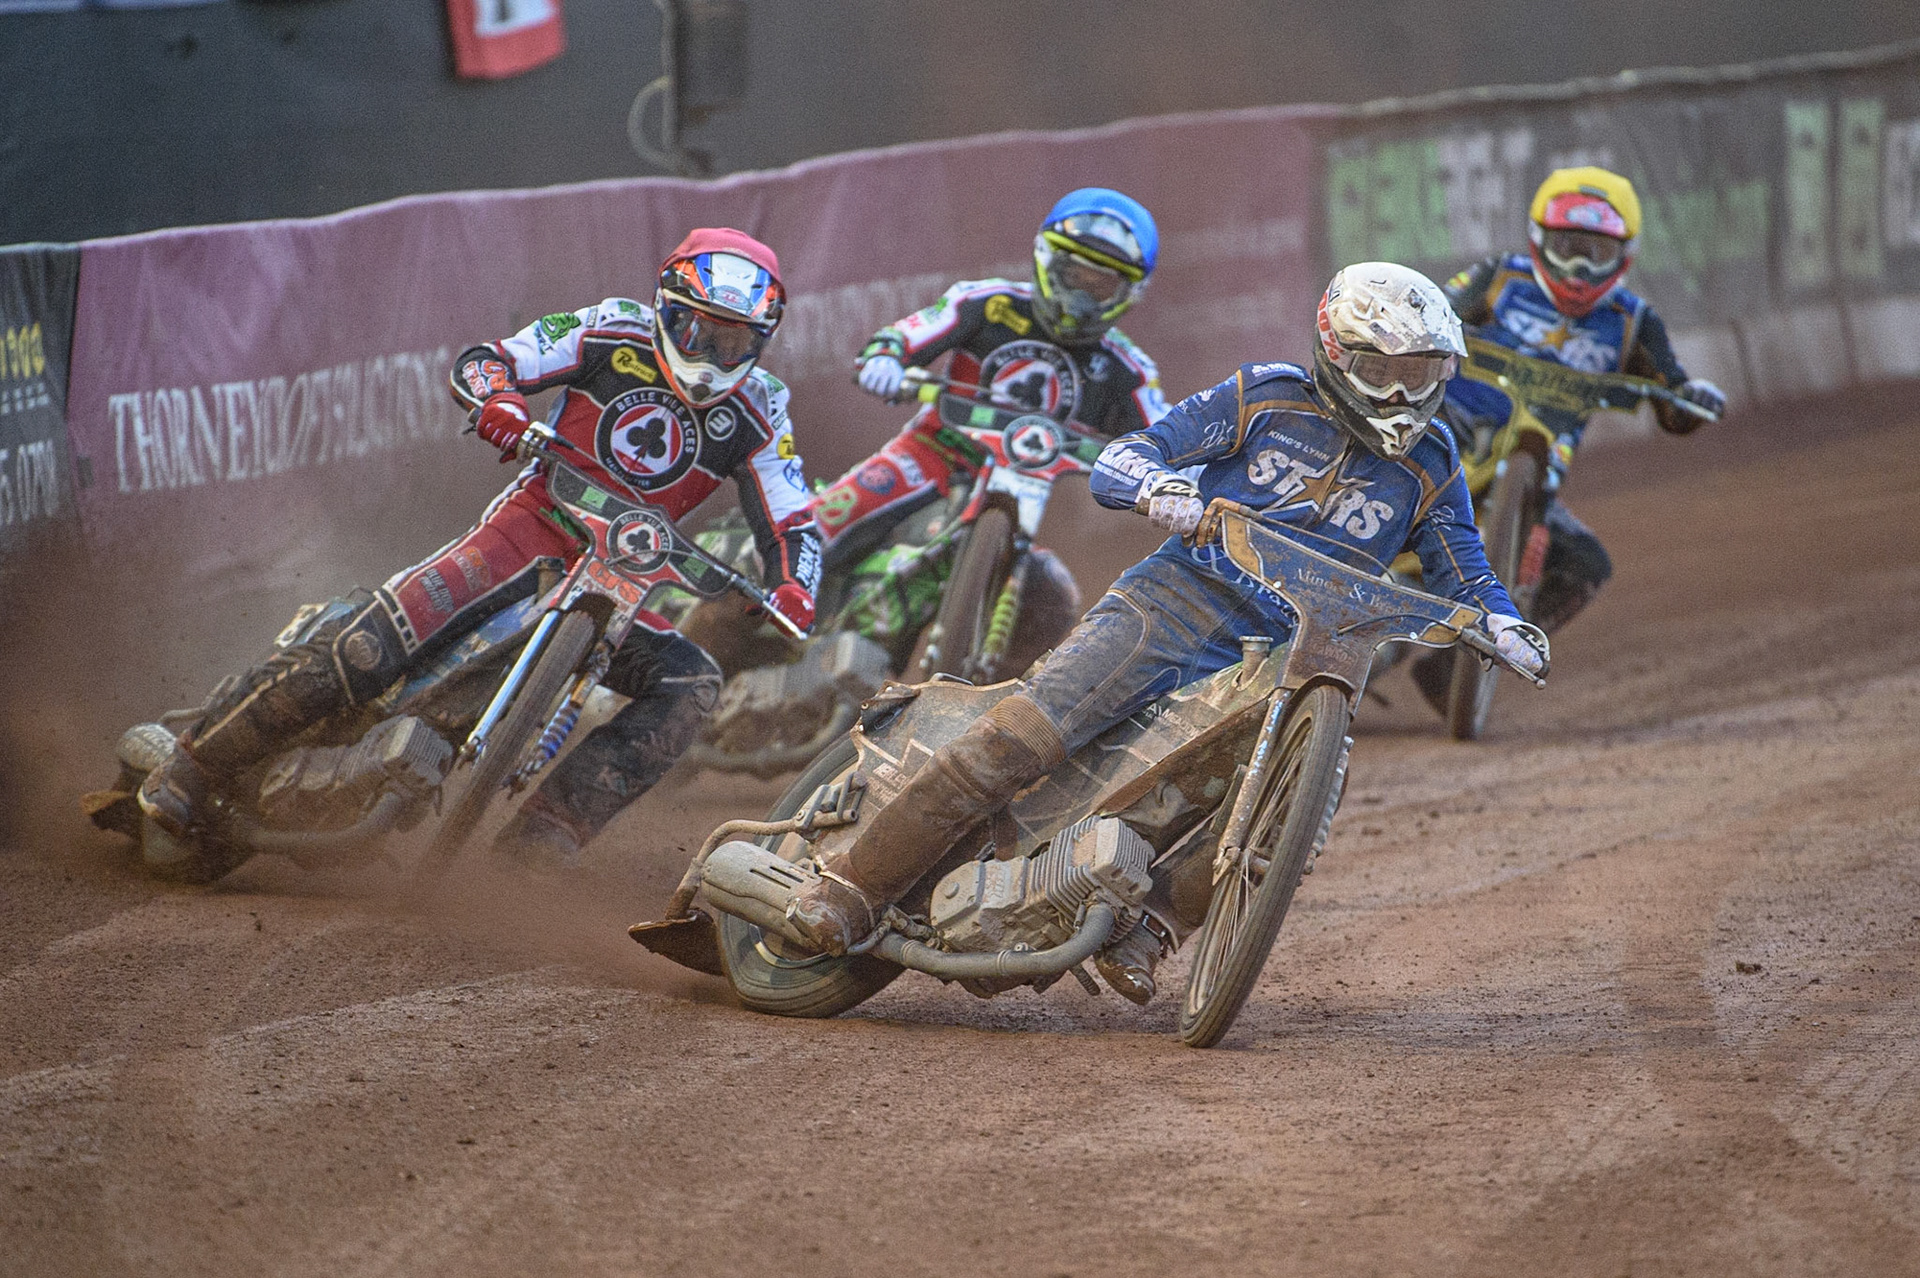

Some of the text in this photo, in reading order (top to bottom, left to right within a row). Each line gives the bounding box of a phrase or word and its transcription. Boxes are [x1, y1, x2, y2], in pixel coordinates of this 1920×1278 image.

[616, 392, 656, 412] BELLE
[662, 394, 686, 416] VUE
[682, 420, 696, 453] ACES
[1267, 429, 1331, 462] KING'S LYNN
[620, 513, 643, 526] BELLE
[647, 516, 663, 531] VUE
[1349, 582, 1367, 600] &
